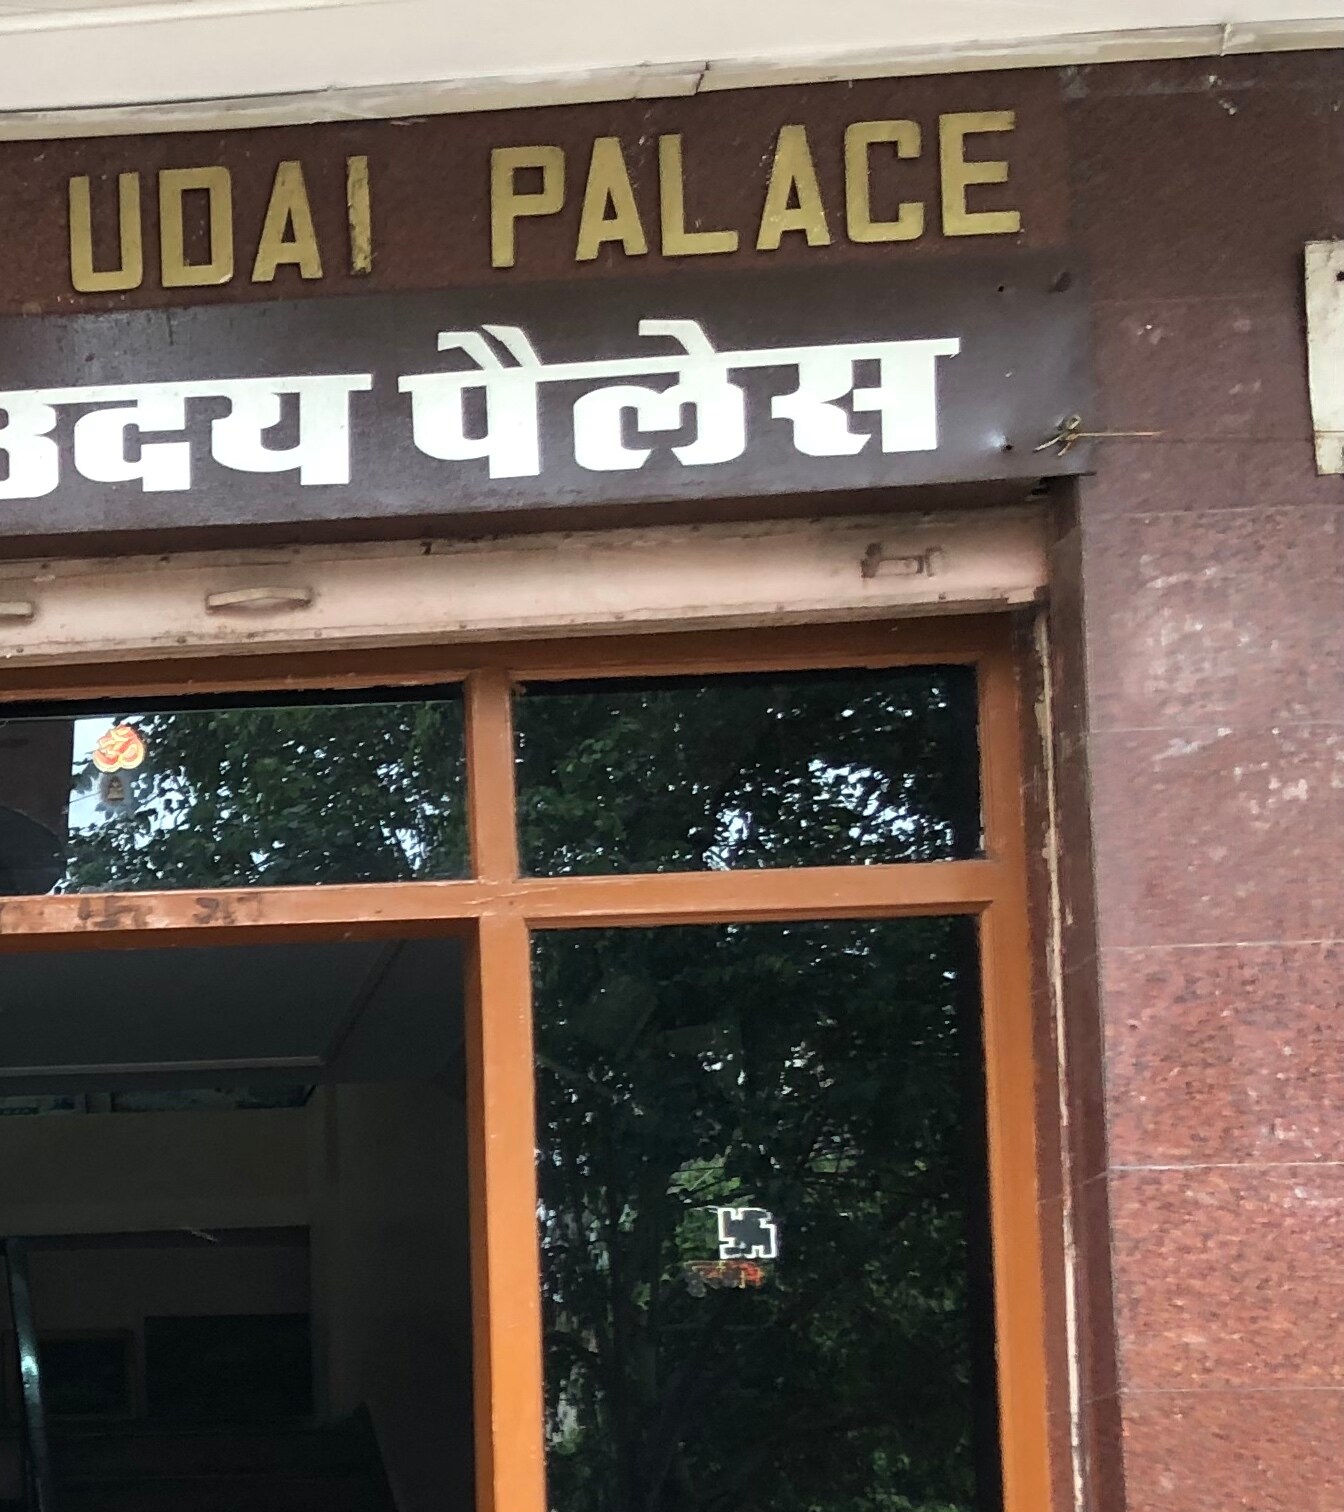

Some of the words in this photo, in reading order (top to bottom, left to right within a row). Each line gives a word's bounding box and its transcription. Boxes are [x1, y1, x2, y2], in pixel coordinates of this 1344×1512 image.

[69, 155, 373, 293] UDAI
[490, 110, 1021, 268] PALACE
[397, 319, 961, 480] पैलेस
